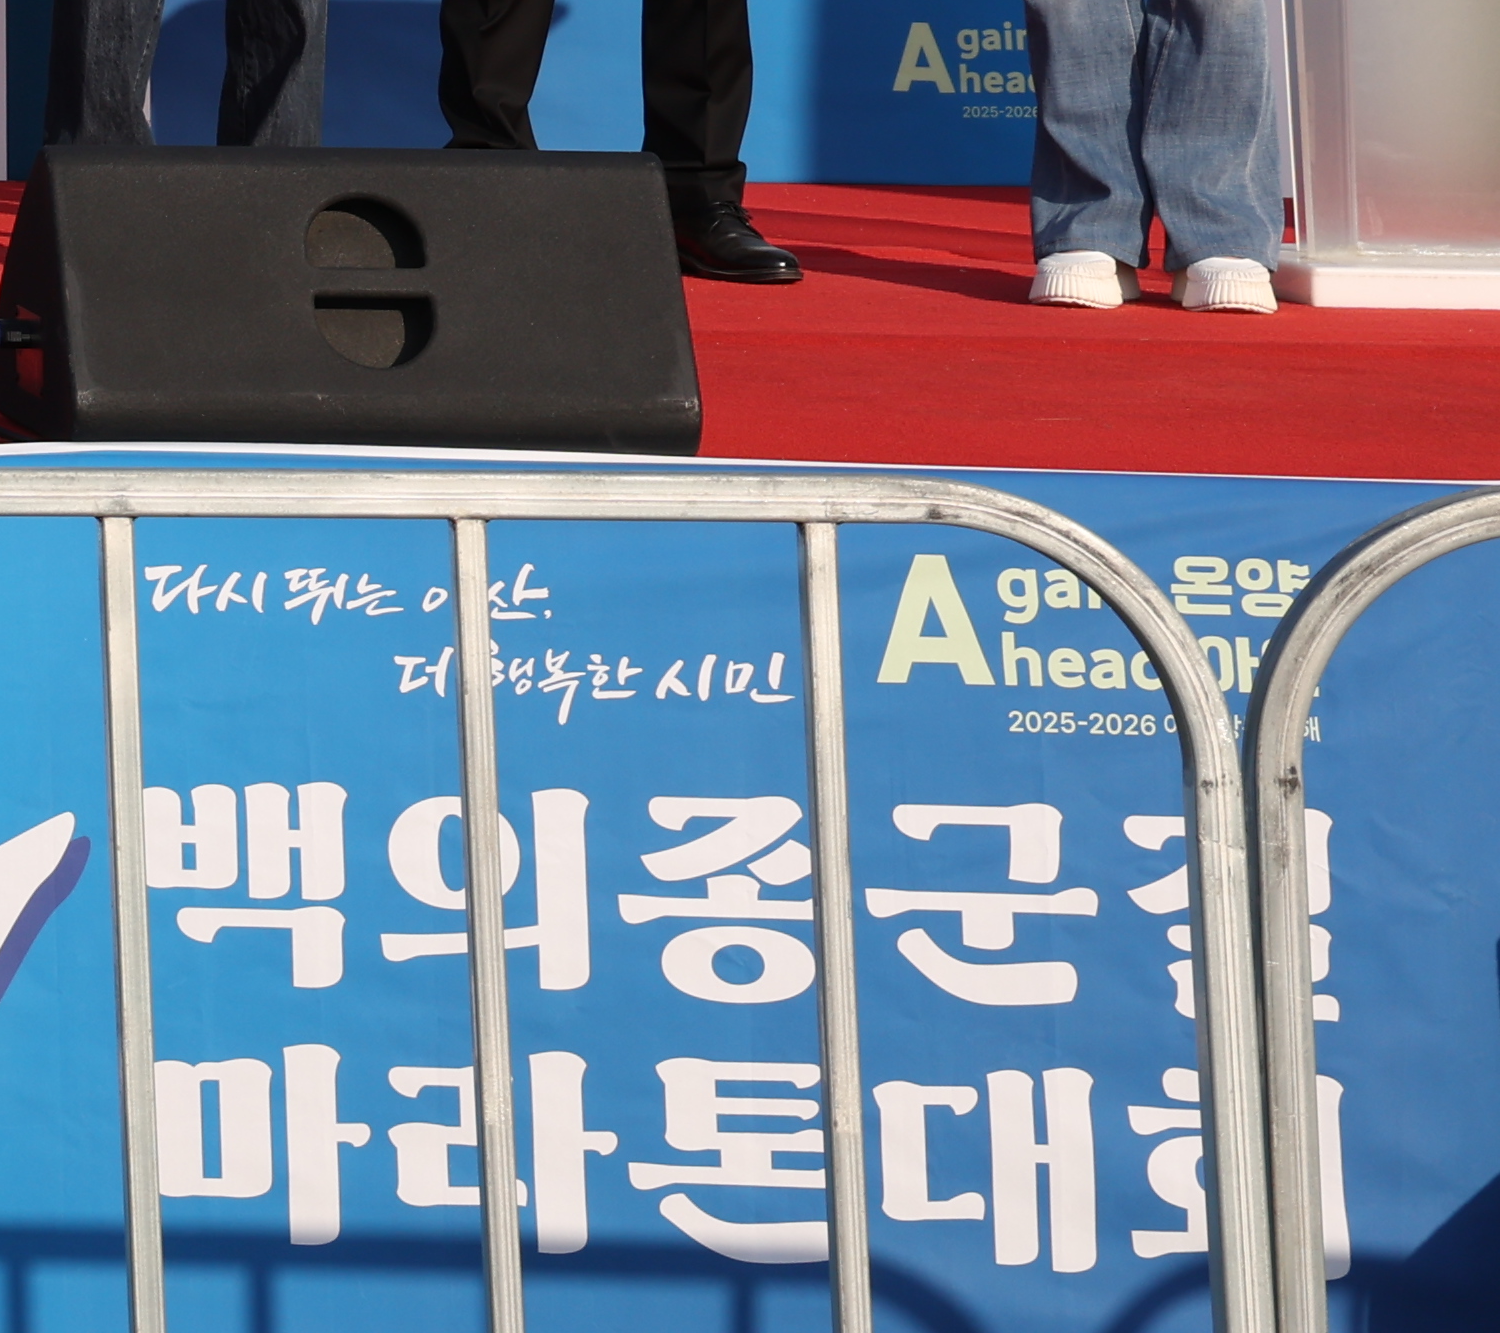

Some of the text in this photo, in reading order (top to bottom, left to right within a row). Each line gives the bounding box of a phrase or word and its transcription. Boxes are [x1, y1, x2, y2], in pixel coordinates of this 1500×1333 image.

[145, 565, 268, 615] 다시
[283, 567, 405, 625] 뛰는
[393, 646, 456, 698] 더
[655, 651, 797, 704] 시민
[1007, 710, 1157, 737] 2025-2026
